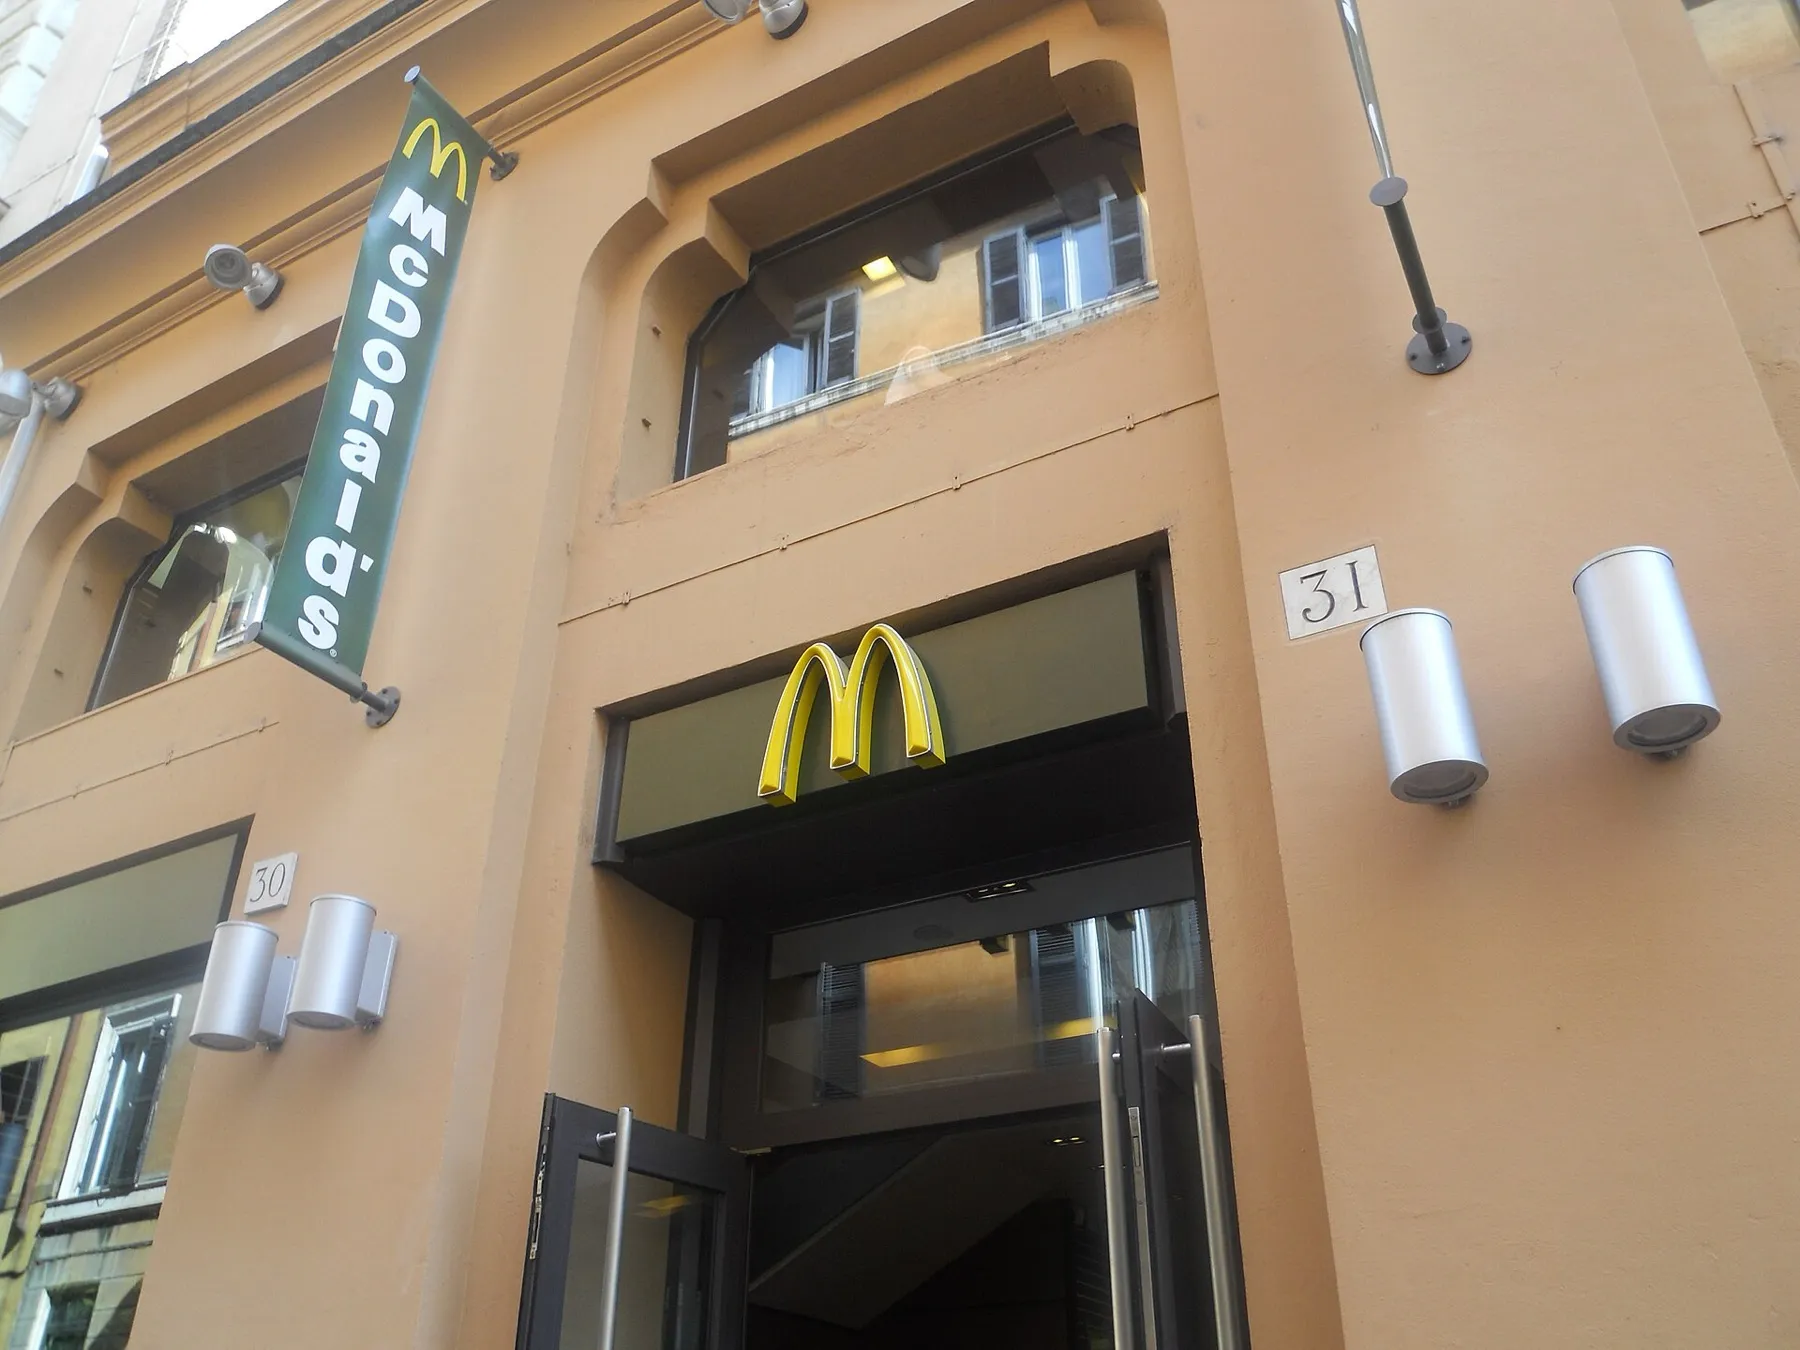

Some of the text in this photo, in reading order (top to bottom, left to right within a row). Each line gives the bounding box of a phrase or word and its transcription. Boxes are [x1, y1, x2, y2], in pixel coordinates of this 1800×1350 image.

[297, 186, 447, 651] McDonald's
[1299, 560, 1369, 623] 31
[249, 862, 286, 903] 30
